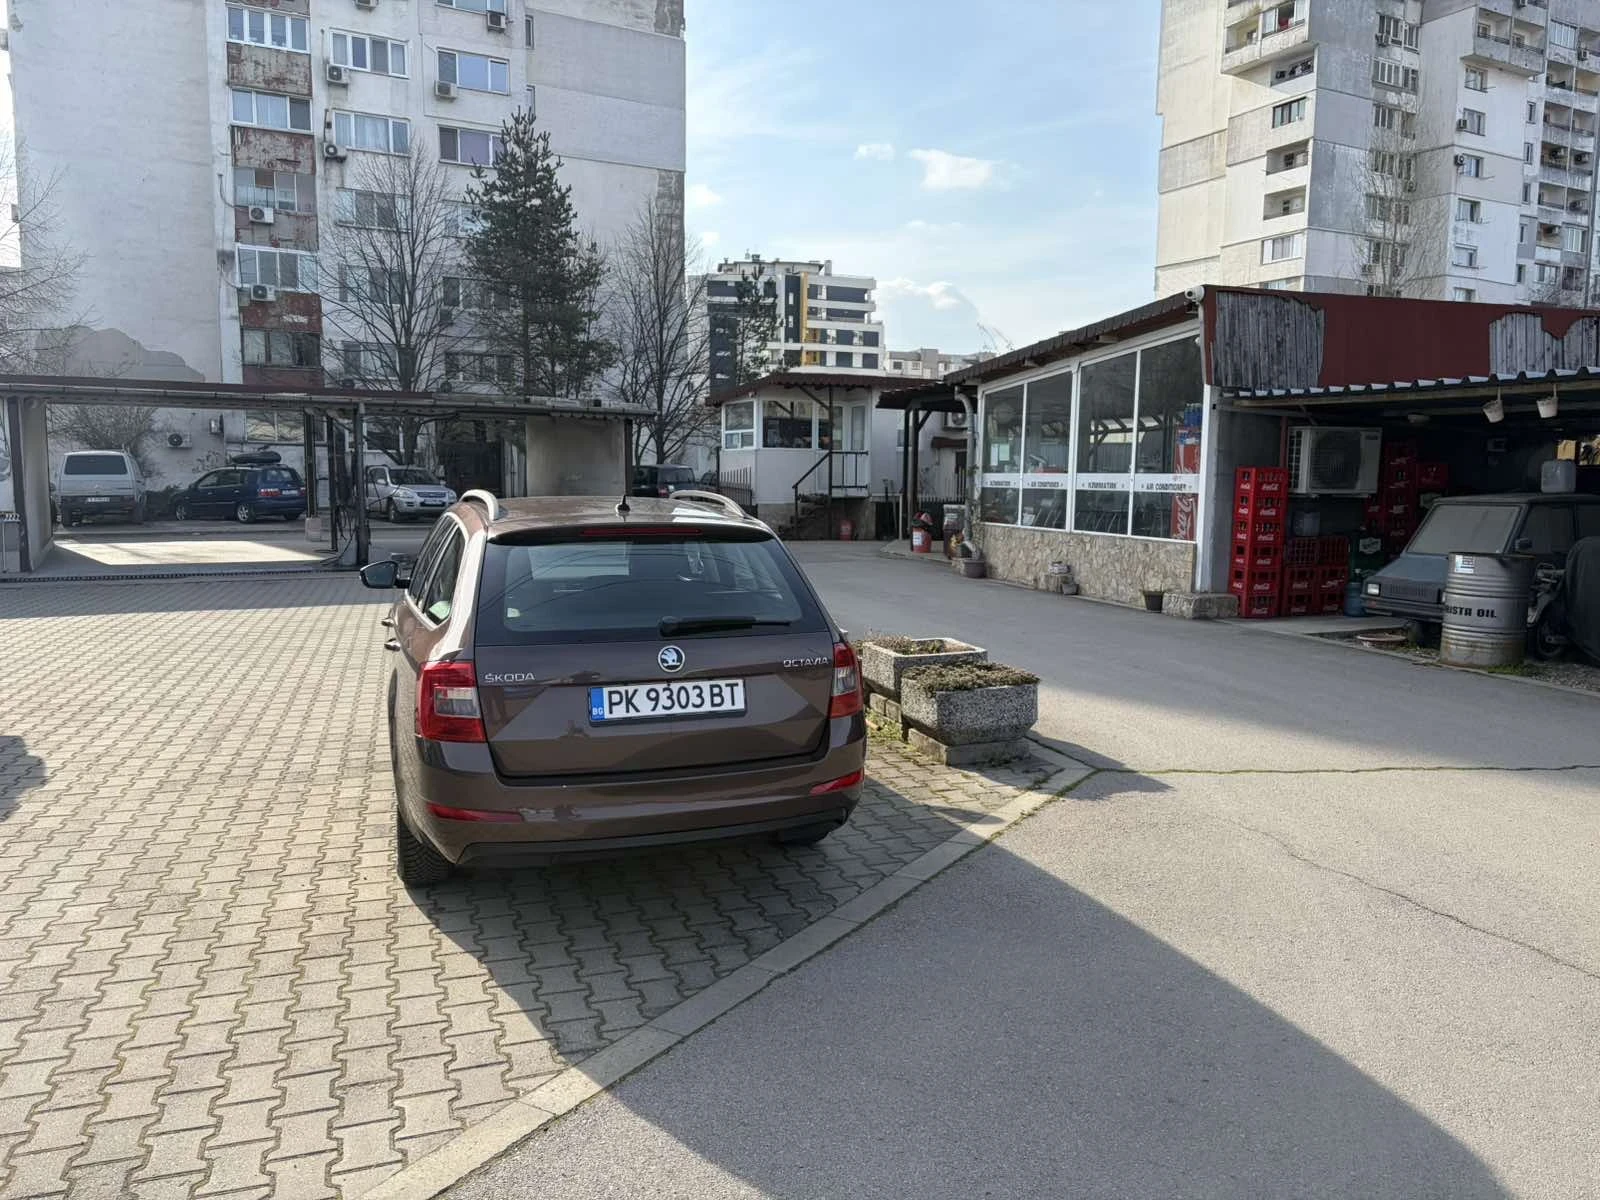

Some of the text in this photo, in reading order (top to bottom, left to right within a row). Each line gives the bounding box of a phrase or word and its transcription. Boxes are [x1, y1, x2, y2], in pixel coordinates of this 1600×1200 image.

[783, 656, 829, 668] OCTAVIA
[485, 672, 535, 683] ŠKODA
[607, 683, 739, 715] PK 9303 BT
[592, 707, 604, 716] BG
